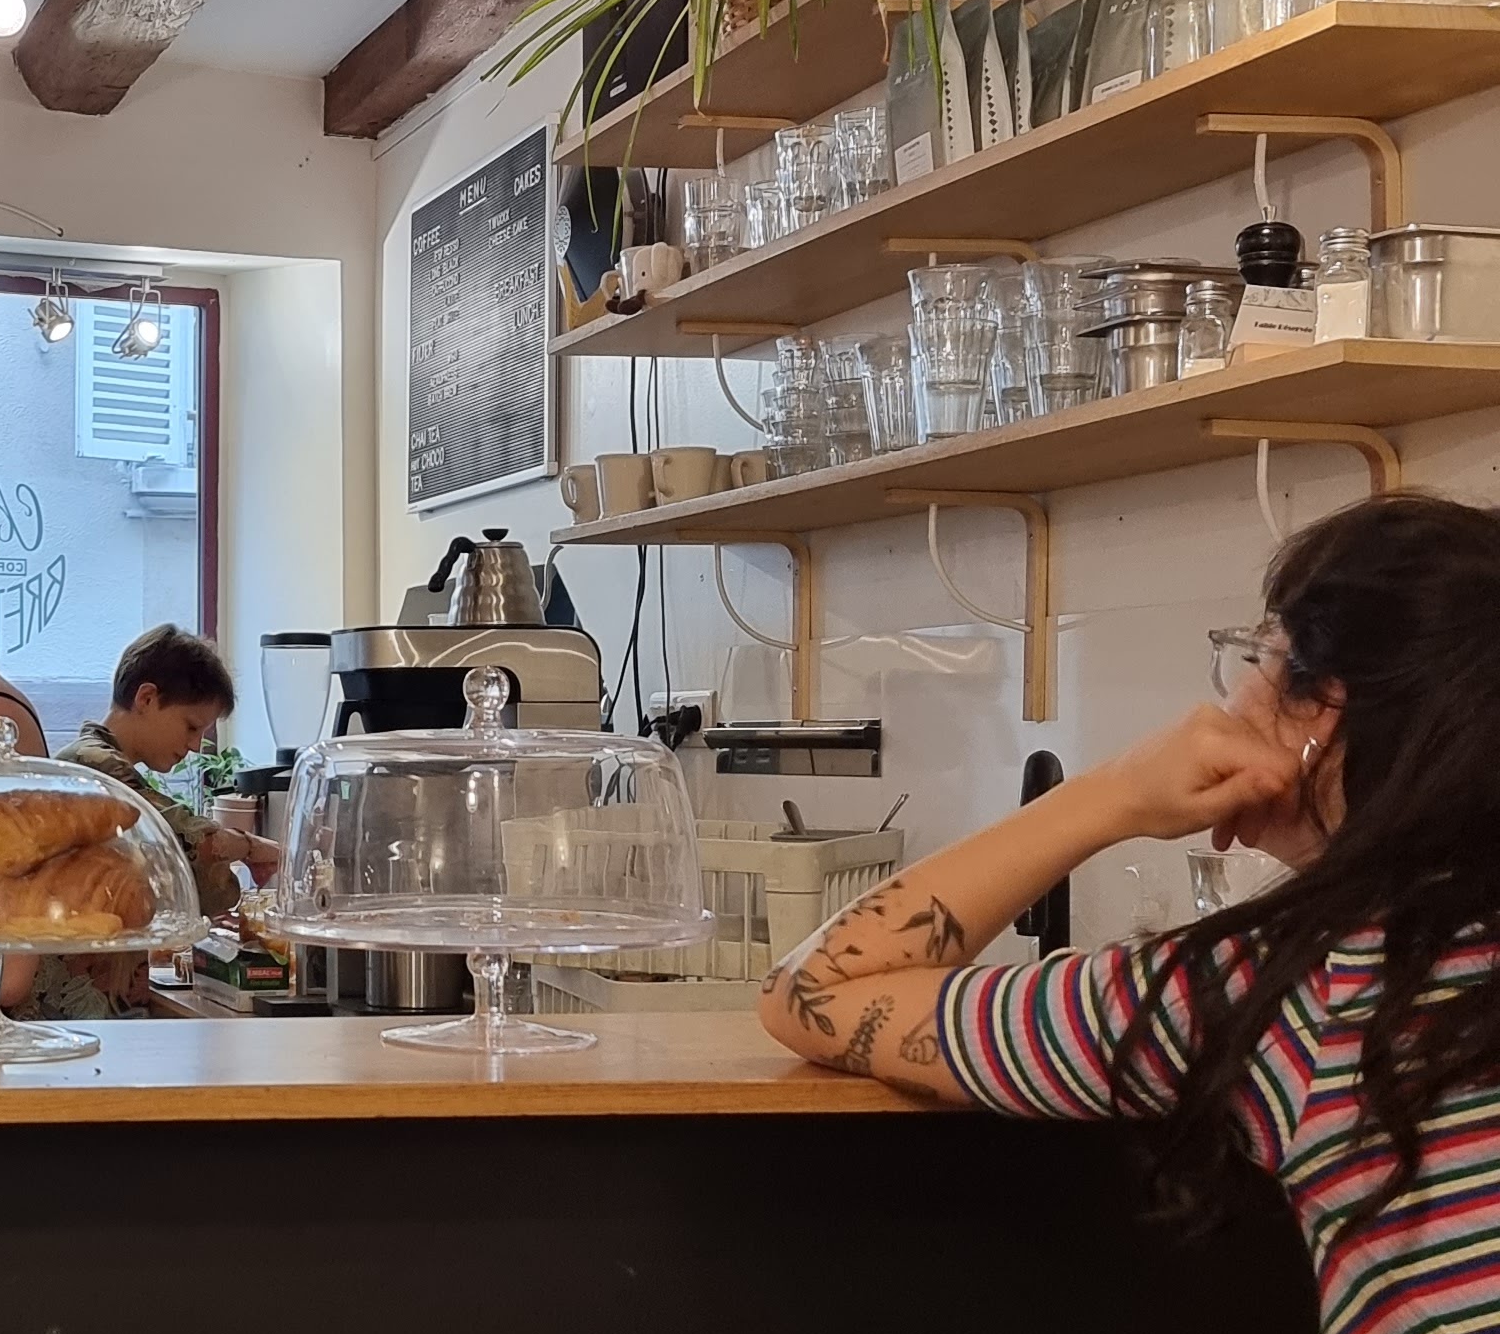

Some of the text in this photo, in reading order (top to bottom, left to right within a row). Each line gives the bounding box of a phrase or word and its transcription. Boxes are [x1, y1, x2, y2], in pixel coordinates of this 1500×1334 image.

[459, 175, 487, 209] MENU
[514, 164, 542, 197] CAKES
[413, 225, 441, 257] COFFEE
[495, 263, 541, 303] BREAKFAST
[513, 302, 540, 332] LUNCH
[427, 423, 440, 445] TEA
[410, 473, 423, 493] TEA
